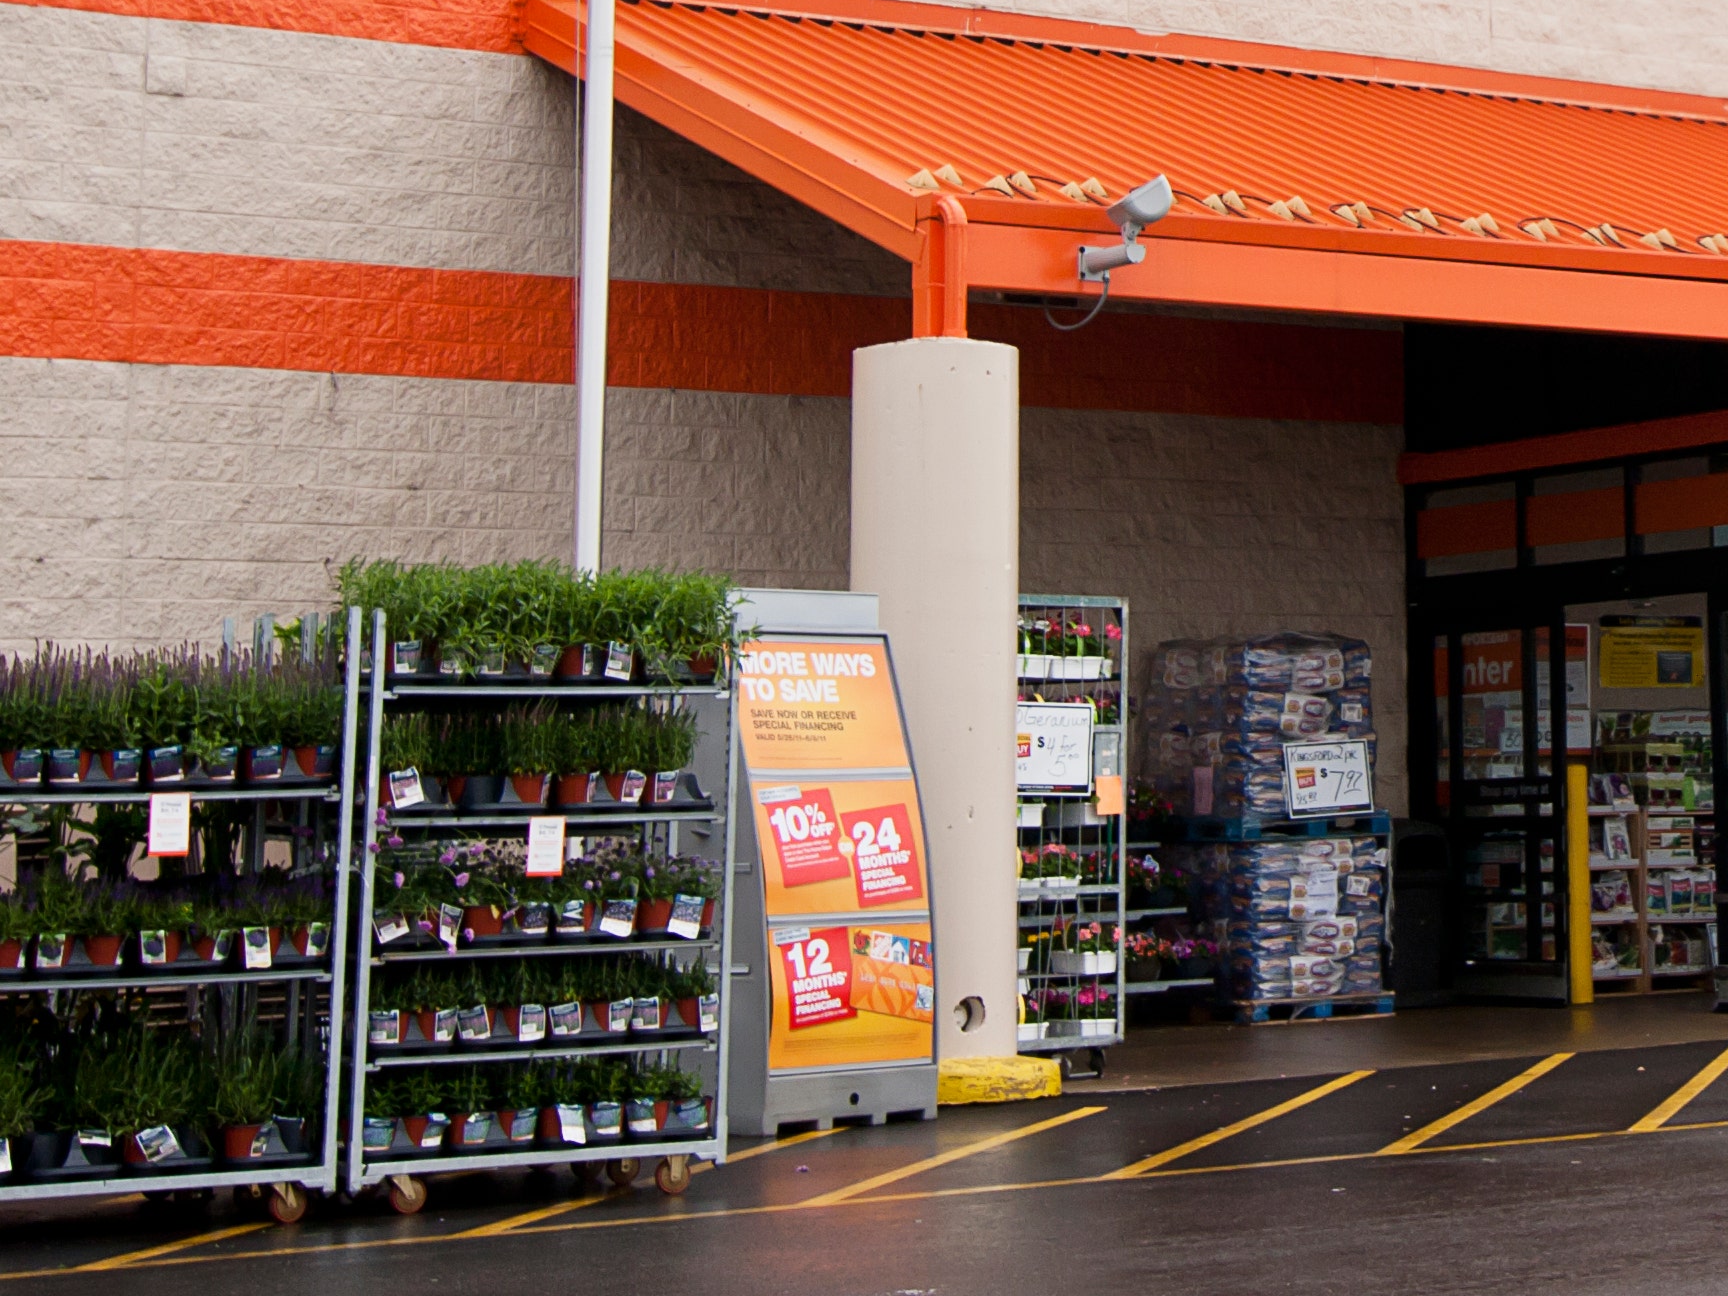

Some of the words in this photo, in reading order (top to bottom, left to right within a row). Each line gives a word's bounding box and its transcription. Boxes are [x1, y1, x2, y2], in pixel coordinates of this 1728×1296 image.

[739, 650, 808, 676] MORE
[810, 652, 876, 678] WAYS
[1463, 656, 1514, 685] nter
[740, 677, 776, 702] TO
[779, 678, 840, 703] SAVE
[750, 708, 774, 719] SAVE
[777, 709, 798, 719] NOW
[800, 710, 814, 720] OR
[816, 710, 857, 720] RECEIVE
[753, 720, 792, 730] SPECIAL
[794, 721, 844, 731] FINANCING
[852, 817, 902, 856] 24
[787, 938, 833, 979] 12
